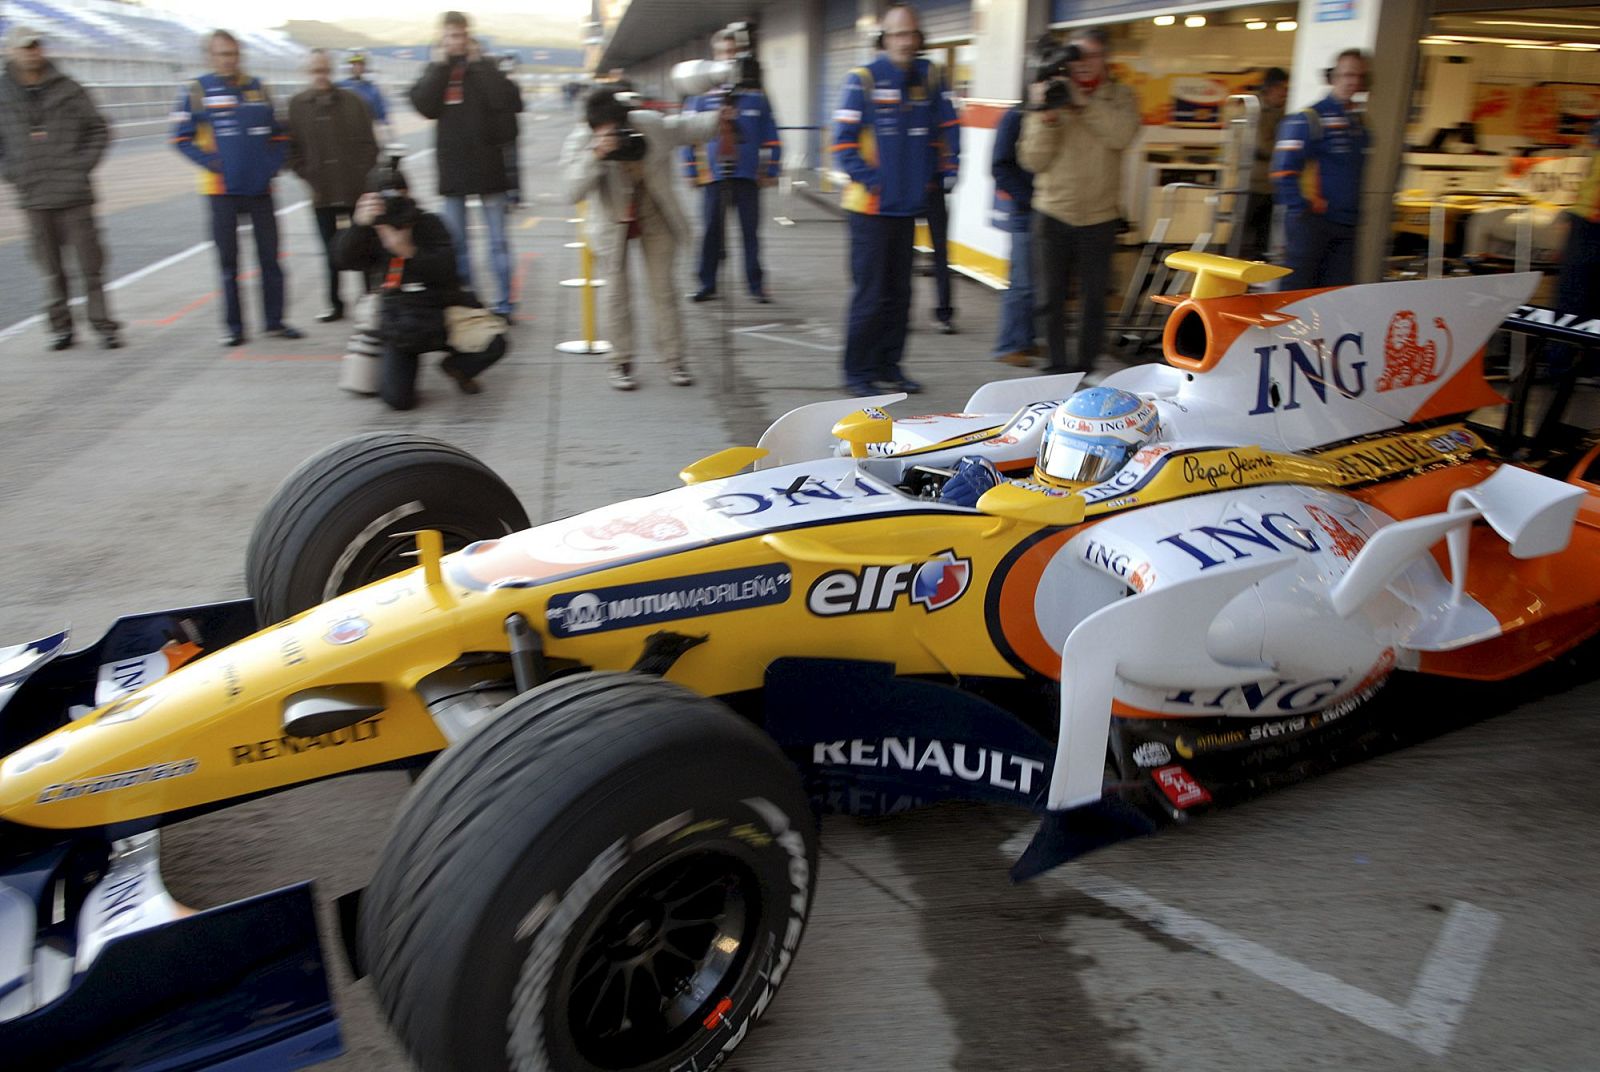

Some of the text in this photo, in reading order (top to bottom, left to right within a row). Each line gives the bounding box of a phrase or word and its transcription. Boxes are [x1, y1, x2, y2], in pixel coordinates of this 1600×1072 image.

[1248, 331, 1369, 416] ING
[1099, 420, 1125, 433] ING
[1084, 470, 1139, 500] ING
[1183, 455, 1230, 488] Pepe
[1156, 509, 1321, 570] ING
[1085, 540, 1131, 577] ING
[807, 561, 914, 616] elf
